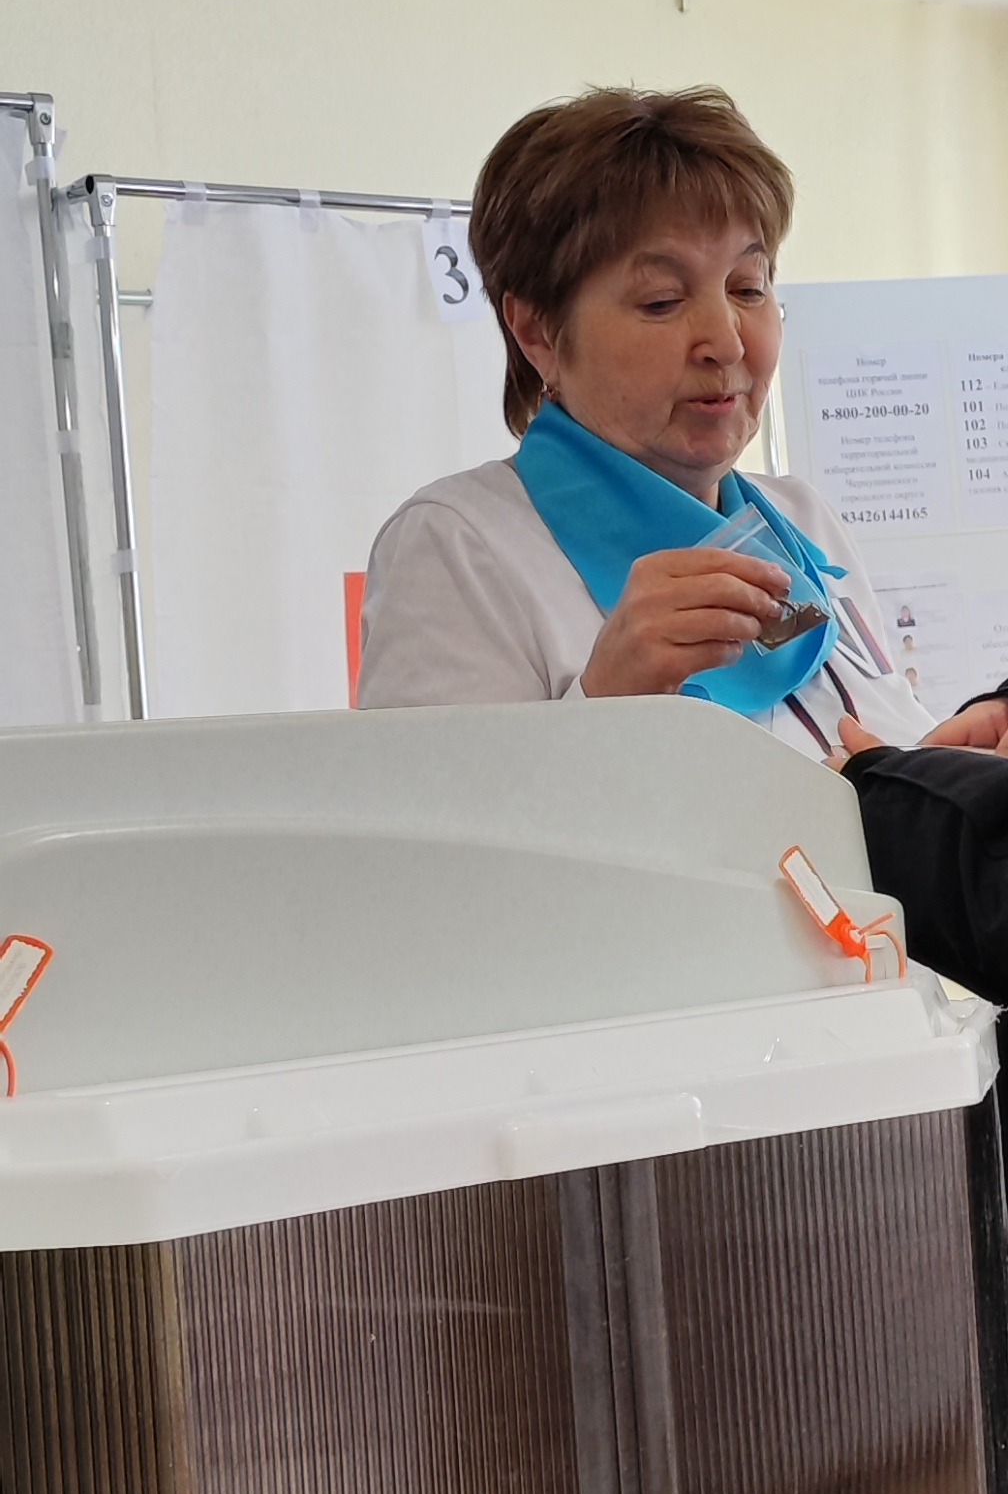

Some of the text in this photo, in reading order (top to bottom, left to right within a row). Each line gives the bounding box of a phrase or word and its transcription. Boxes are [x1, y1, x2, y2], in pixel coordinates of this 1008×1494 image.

[434, 246, 469, 304] 3
[961, 378, 984, 392] 112
[821, 403, 930, 421] 8-800-200-00-20
[963, 400, 984, 413] 101
[964, 418, 987, 432] 102
[966, 437, 988, 450] 103
[969, 468, 990, 481] 104
[840, 506, 928, 524] 83426144165
